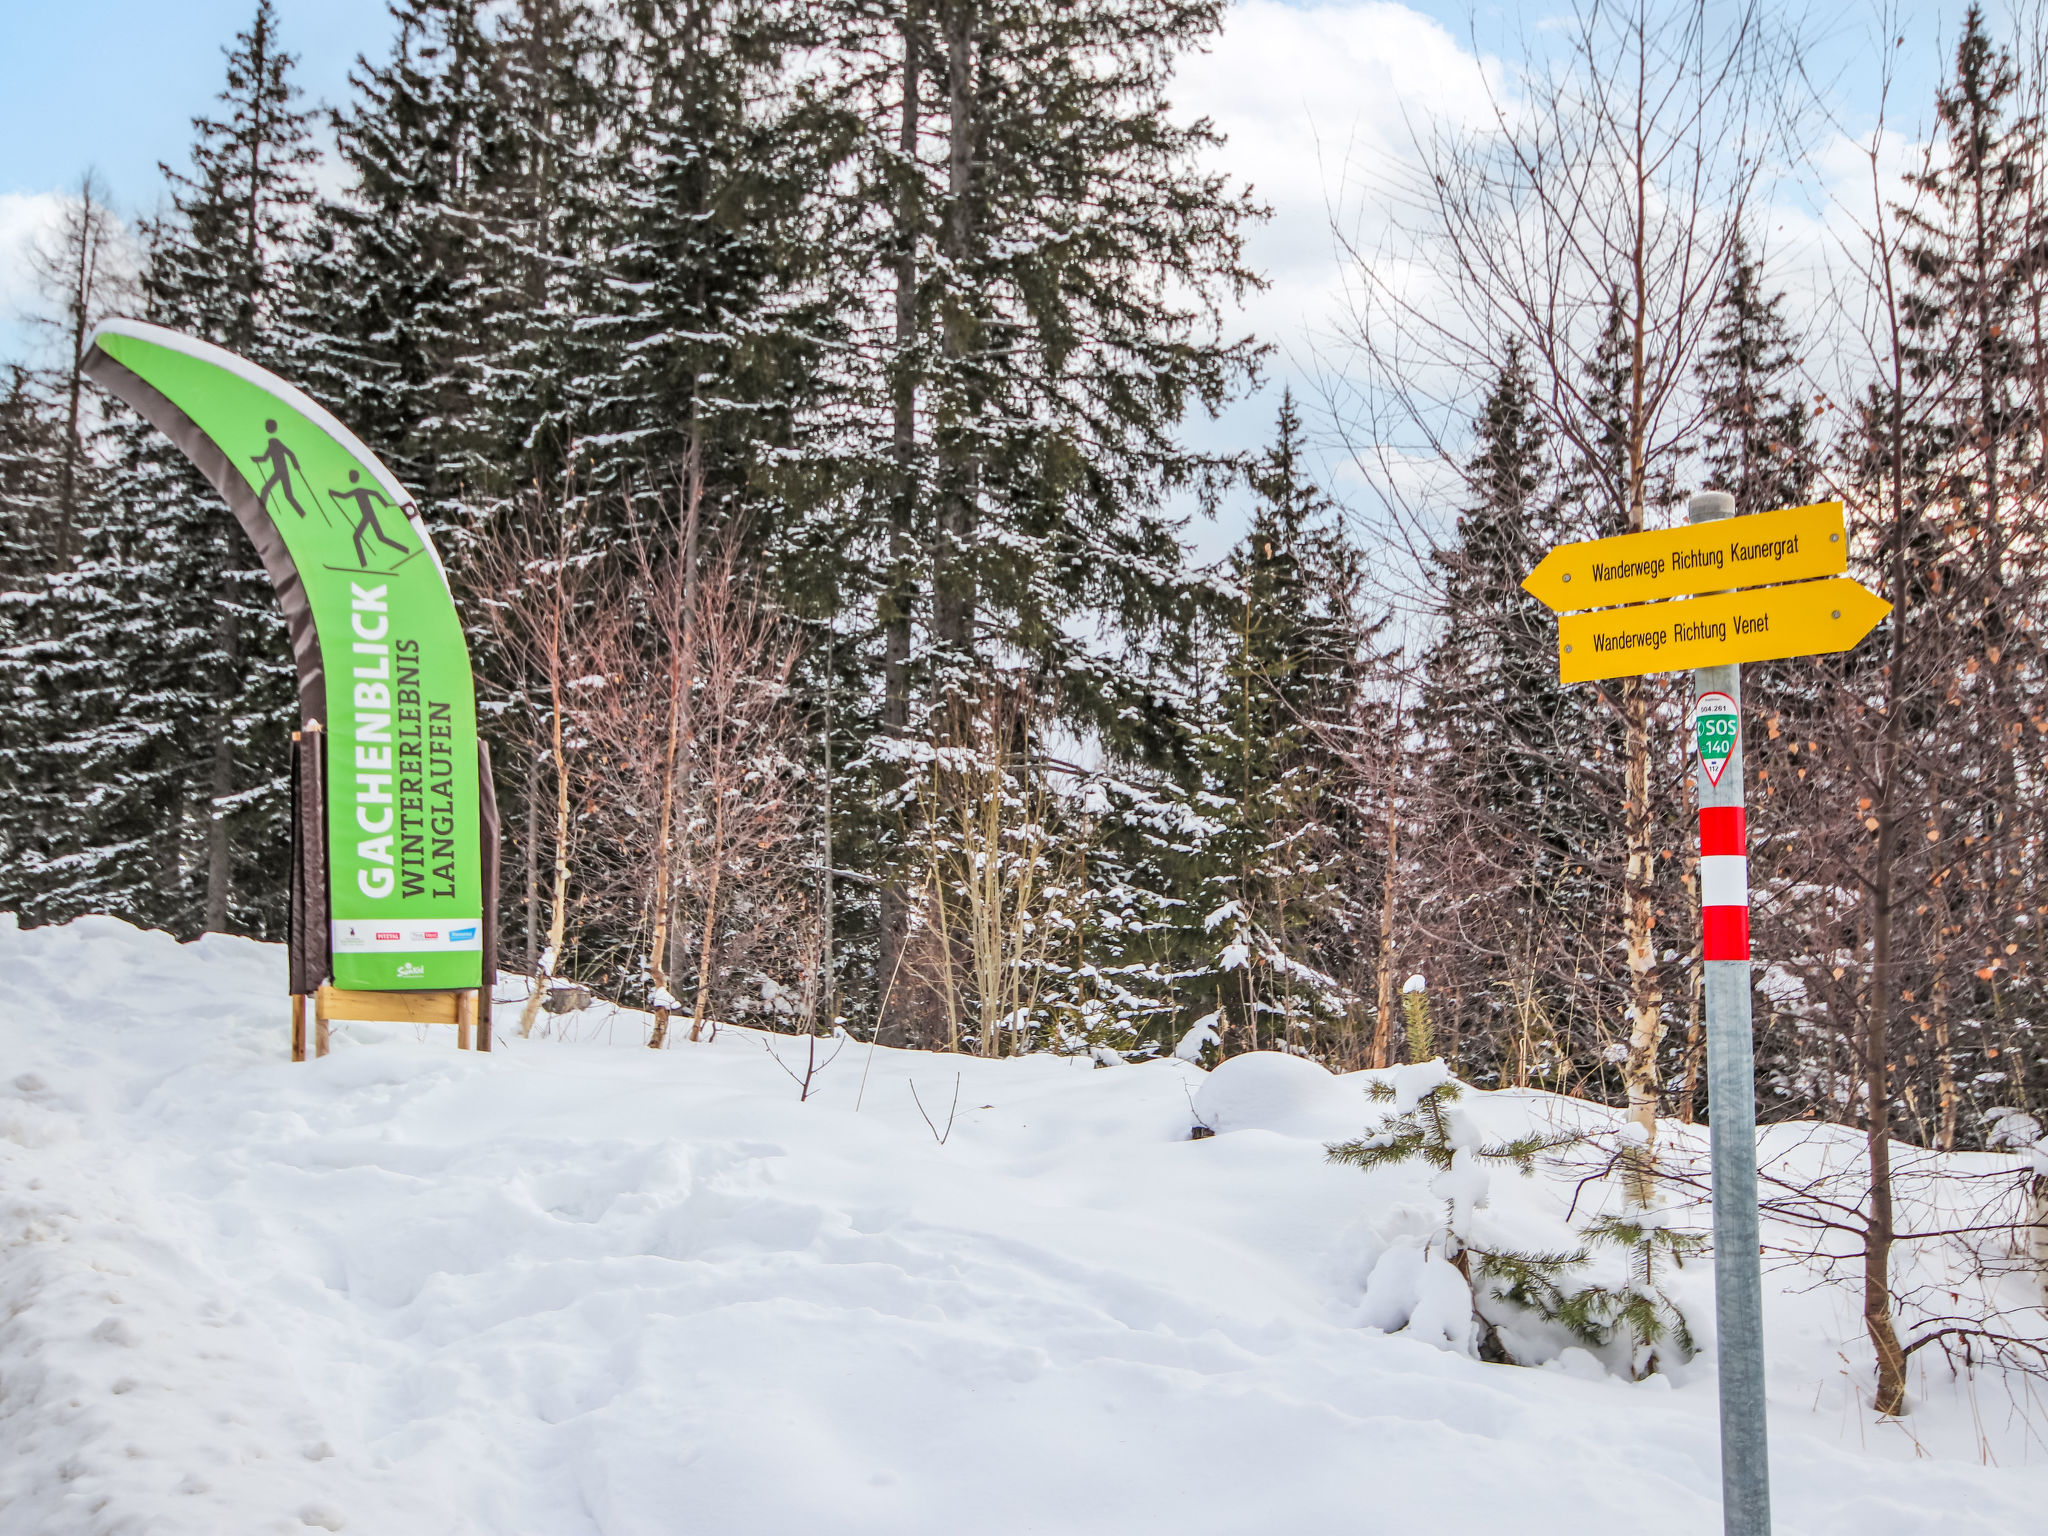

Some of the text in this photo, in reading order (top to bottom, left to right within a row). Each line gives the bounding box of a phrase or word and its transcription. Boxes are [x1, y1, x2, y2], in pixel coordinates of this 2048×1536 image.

[1592, 535, 1799, 583] Wanderwege Richtung Kaunergrat
[1593, 613, 1769, 653] Wanderwege Richtung Venet
[350, 582, 395, 899] GACHENBLICK
[1706, 719, 1737, 736] SOS
[1706, 740, 1730, 754] 140
[395, 639, 425, 899] WINTERERLEBNIS
[428, 701, 455, 899] LANGLAUFEN
